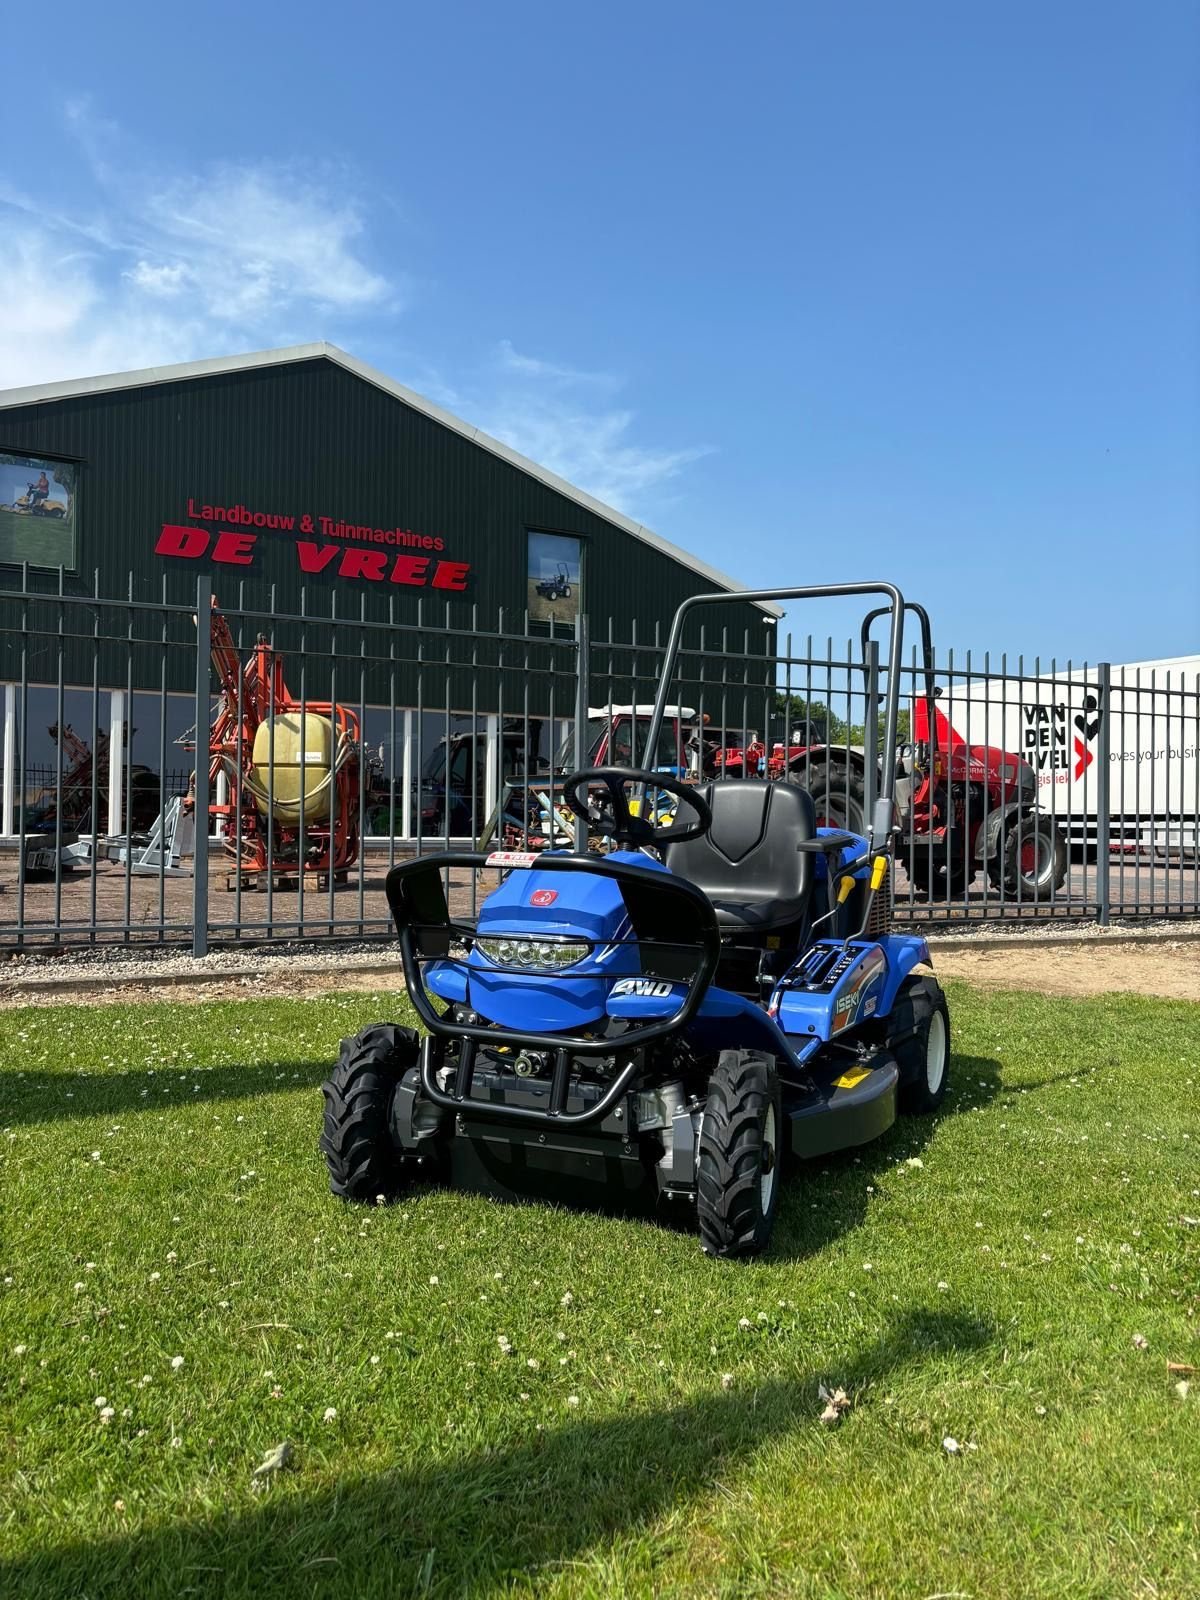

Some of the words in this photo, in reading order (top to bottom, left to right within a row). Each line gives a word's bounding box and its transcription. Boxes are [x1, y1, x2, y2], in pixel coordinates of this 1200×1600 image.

[187, 498, 295, 531] Landbouw
[300, 514, 314, 534] &
[318, 516, 445, 550] Tuinmachines
[154, 524, 257, 565] DE
[296, 540, 471, 590] VREE
[1023, 703, 1065, 725] VAN
[1025, 727, 1065, 747] DEN
[1107, 751, 1135, 762] oves
[1137, 750, 1165, 767] your
[614, 980, 674, 998] 4WD
[836, 991, 859, 1014] ISEKI
